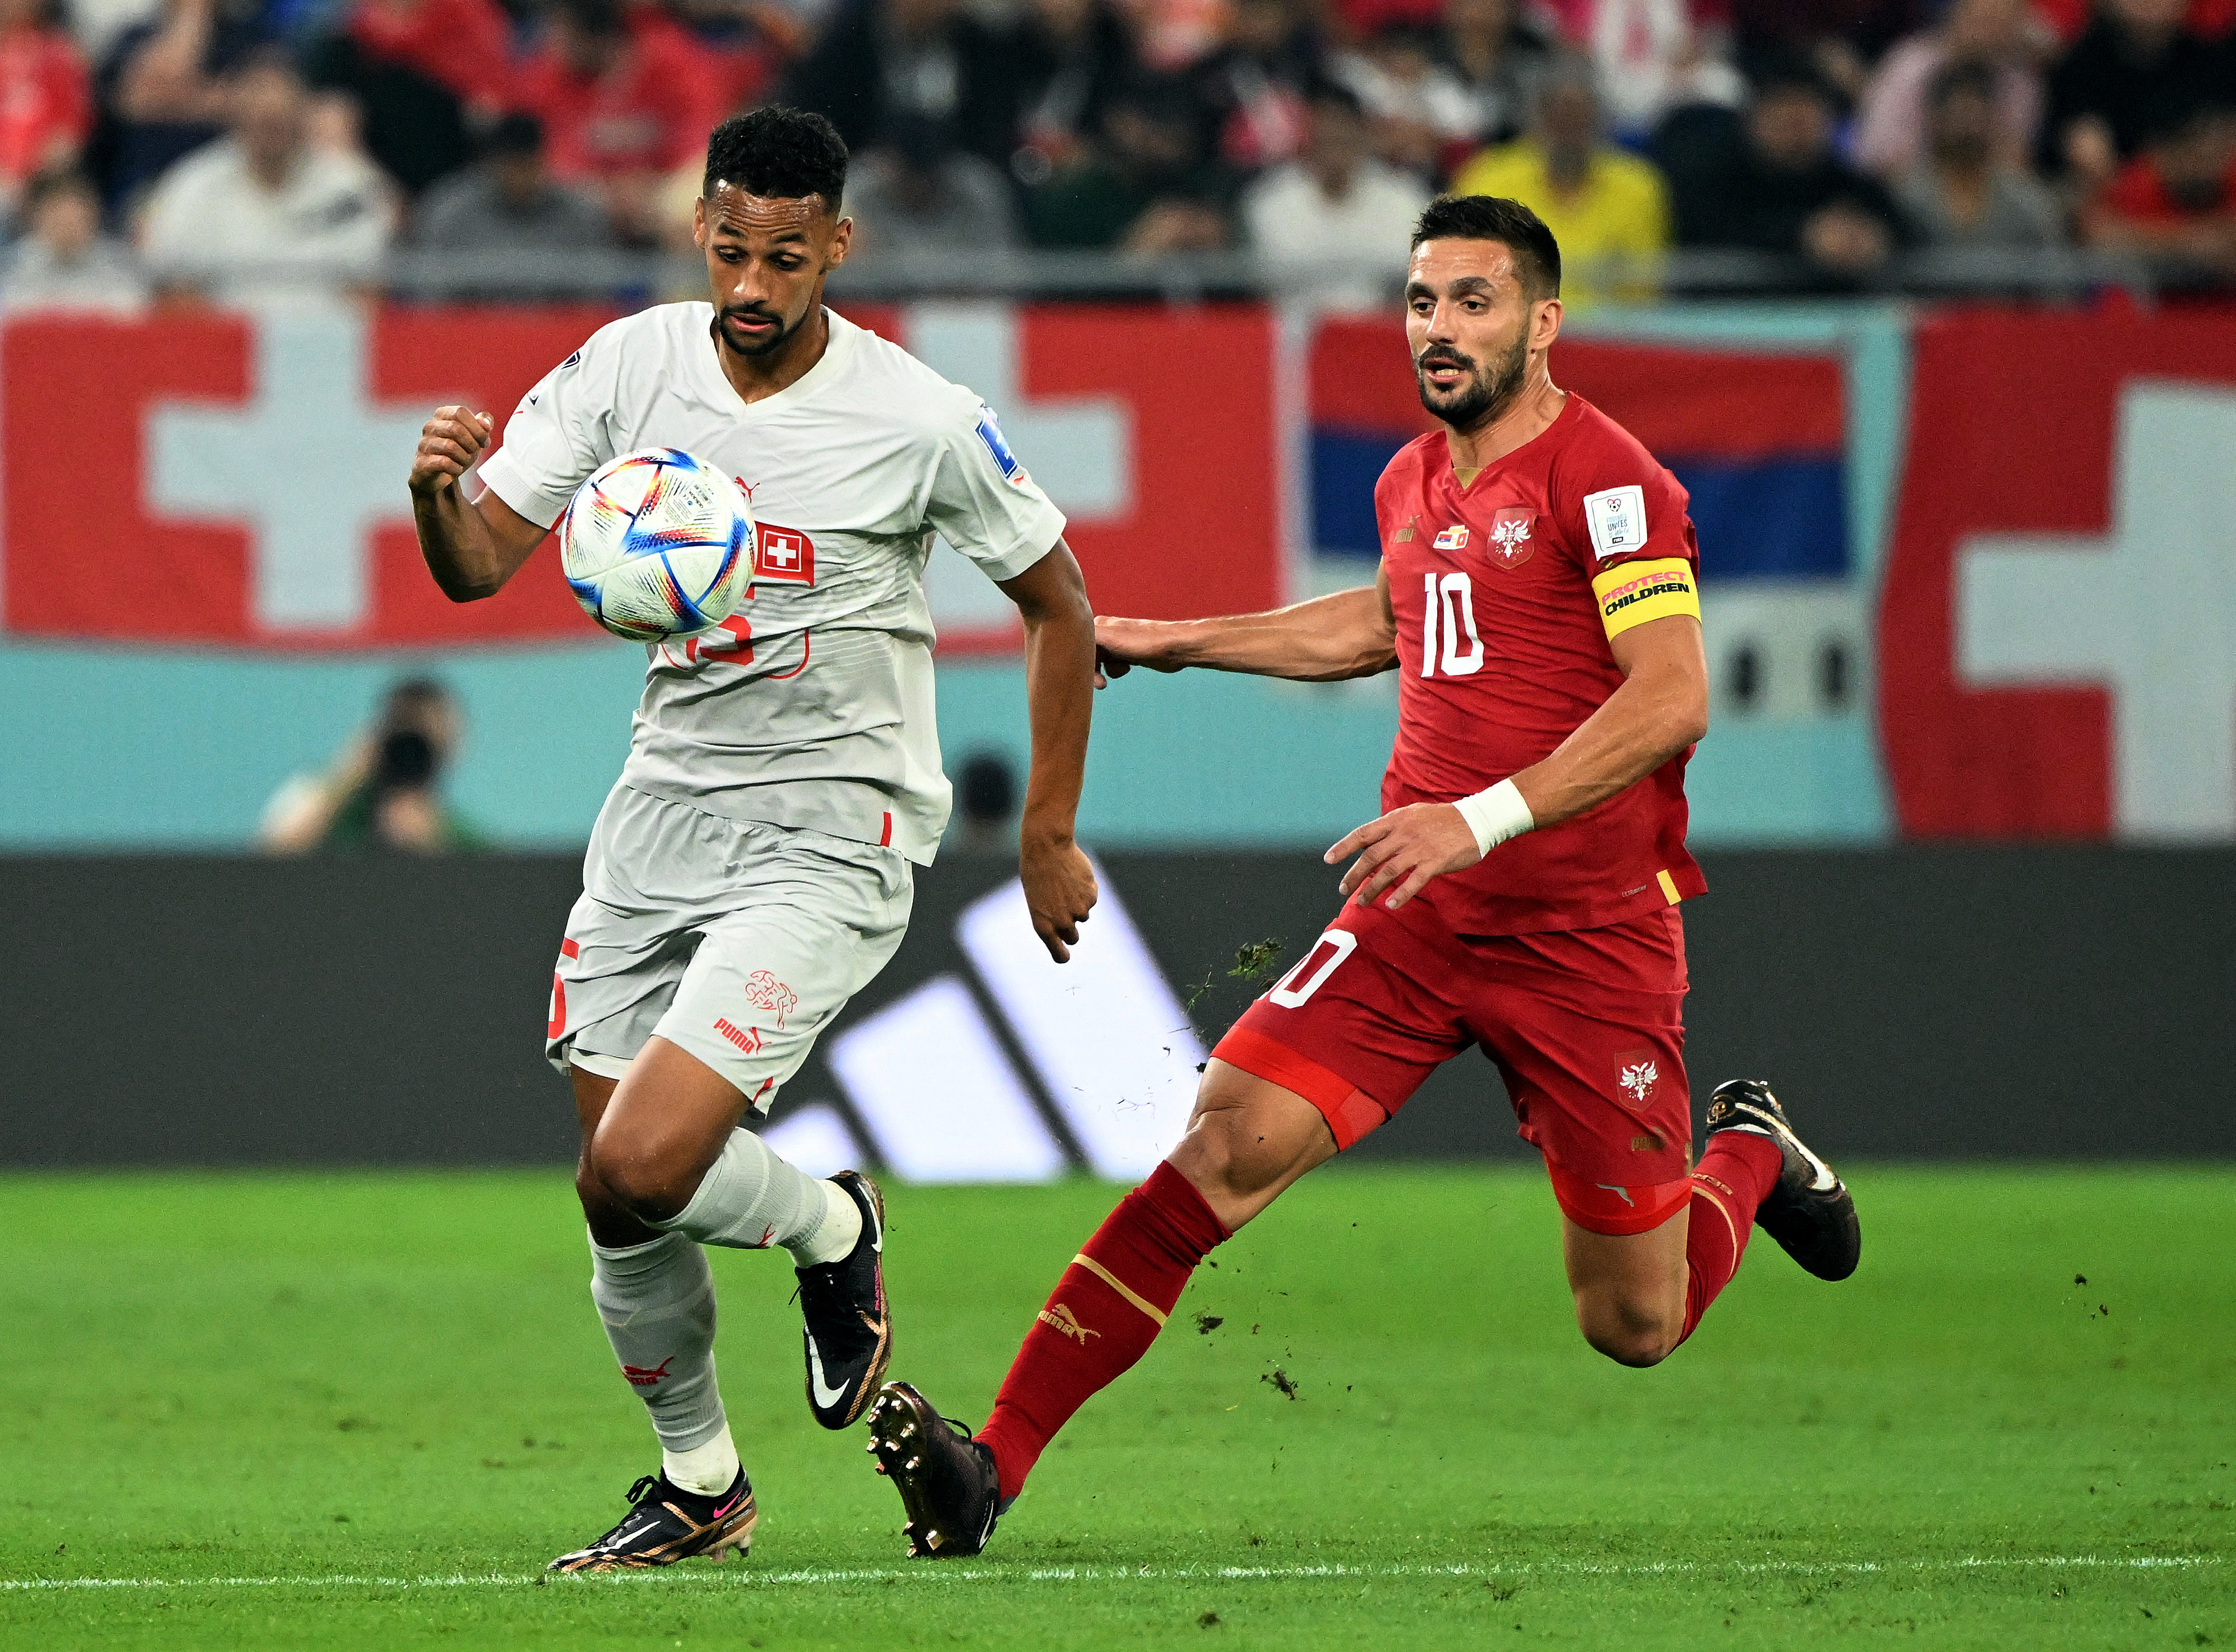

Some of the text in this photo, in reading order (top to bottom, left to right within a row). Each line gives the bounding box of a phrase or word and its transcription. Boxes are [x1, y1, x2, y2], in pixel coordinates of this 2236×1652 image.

[689, 491, 704, 509] adidas
[1607, 519, 1628, 531] UNITES
[1602, 571, 1686, 606] PROTECT
[1605, 583, 1690, 616] CHILDREN
[1420, 572, 1484, 678] 10
[713, 1018, 755, 1054] PUMA
